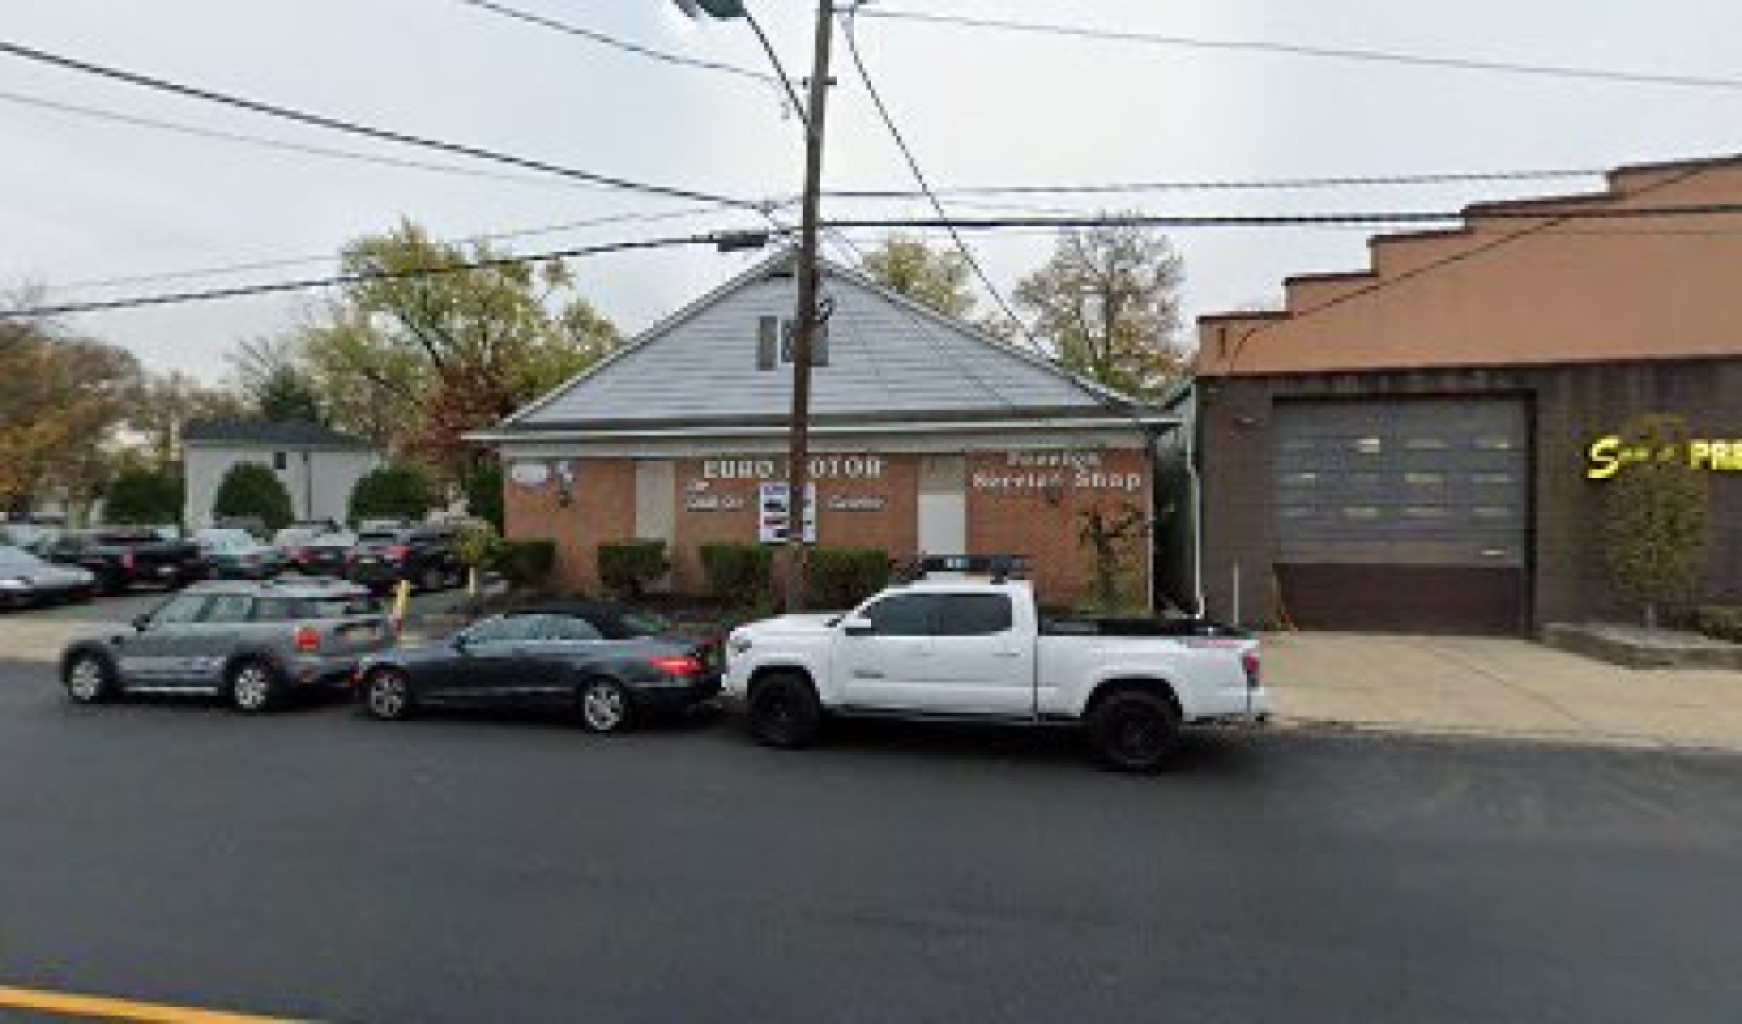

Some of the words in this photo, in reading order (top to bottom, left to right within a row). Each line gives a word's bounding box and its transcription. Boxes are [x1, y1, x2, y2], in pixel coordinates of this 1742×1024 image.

[703, 460, 774, 479] EURO
[786, 459, 882, 479] OTOR
[1075, 472, 1141, 491] Shop
